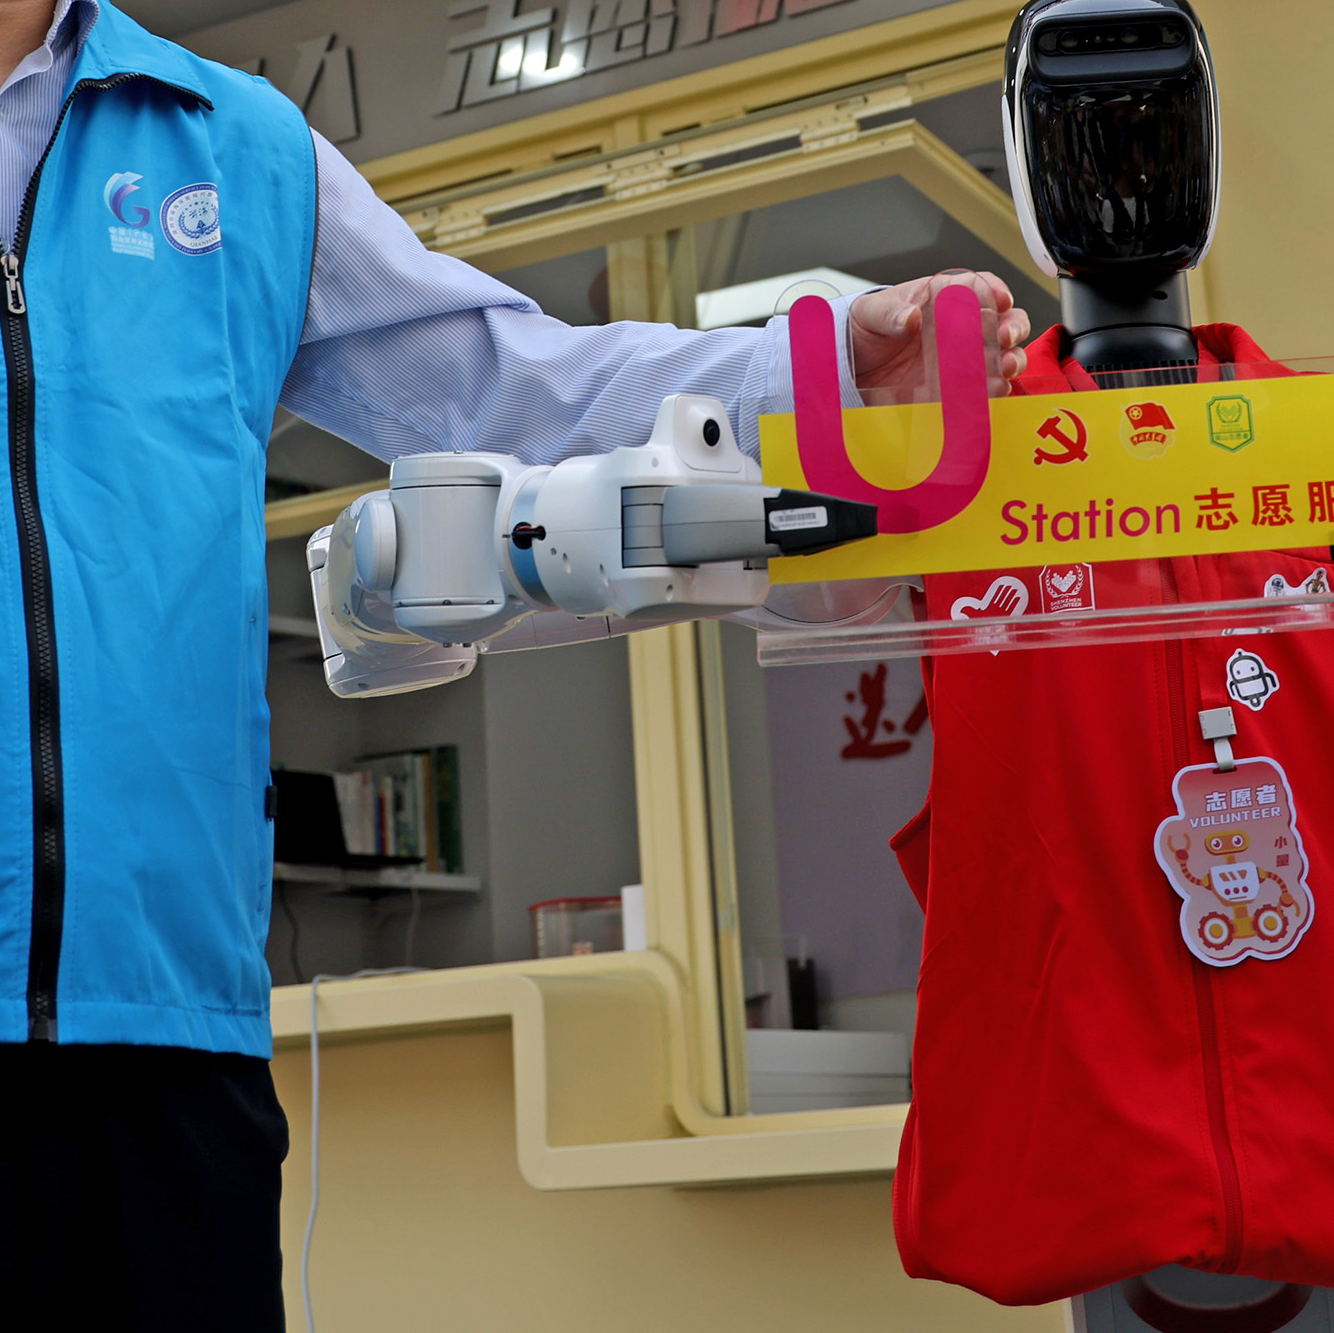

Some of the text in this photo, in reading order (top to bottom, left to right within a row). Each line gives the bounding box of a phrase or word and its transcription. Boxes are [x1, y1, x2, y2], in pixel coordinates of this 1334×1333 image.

[788, 284, 991, 535] U
[1000, 497, 1181, 546] Station
[1050, 597, 1082, 607] SHENZHEN
[1205, 784, 1278, 812] 志愿者
[1189, 806, 1281, 829] VOLUNTEER
